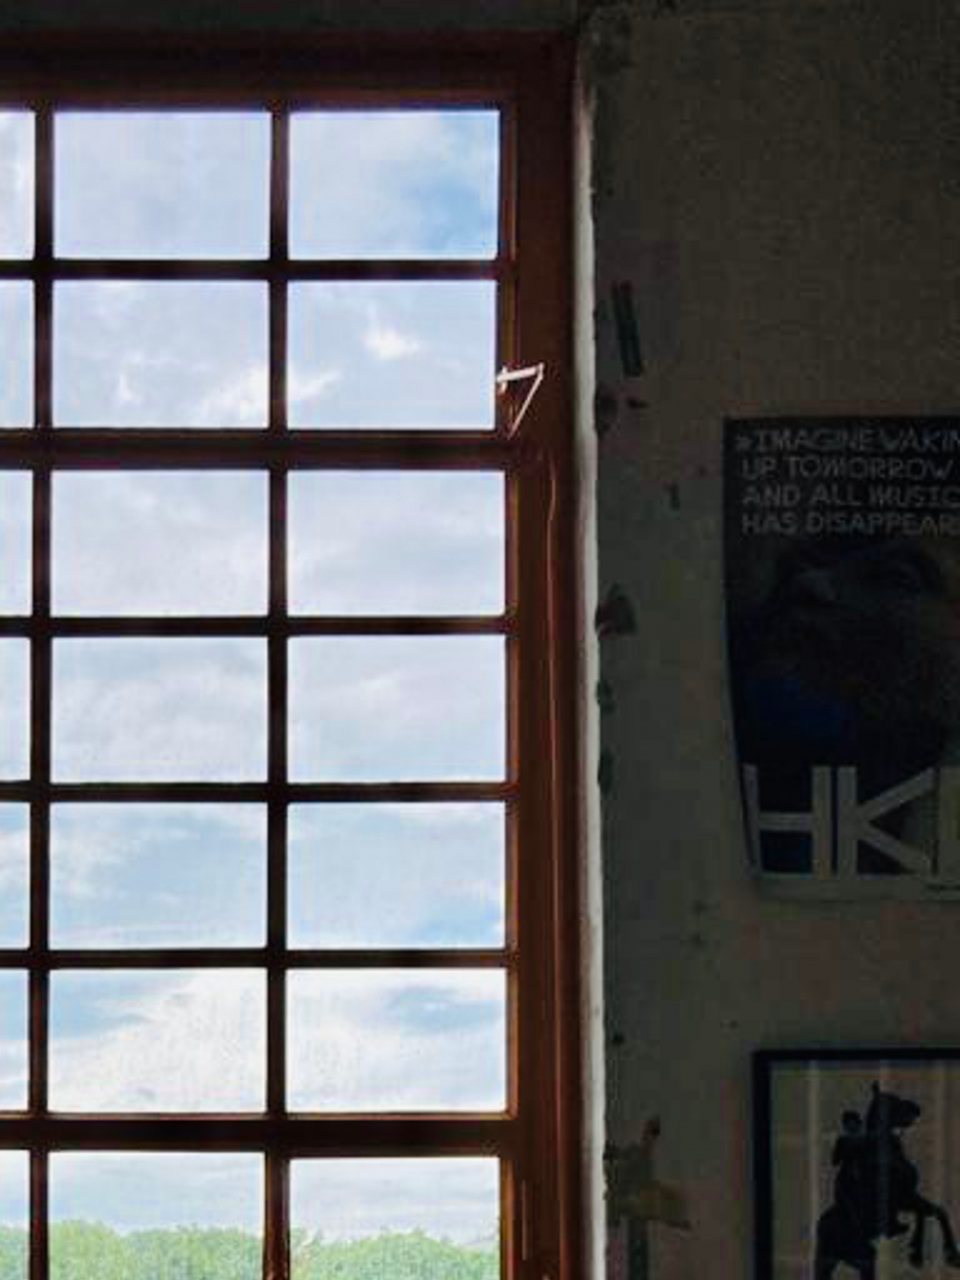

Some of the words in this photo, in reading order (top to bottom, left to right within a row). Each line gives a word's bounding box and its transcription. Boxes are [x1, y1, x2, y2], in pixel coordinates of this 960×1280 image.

[741, 457, 777, 480] UP
[783, 454, 954, 480] TOMORROW
[741, 484, 800, 507] AND
[809, 482, 862, 507] ALL
[741, 511, 796, 535] HAS
